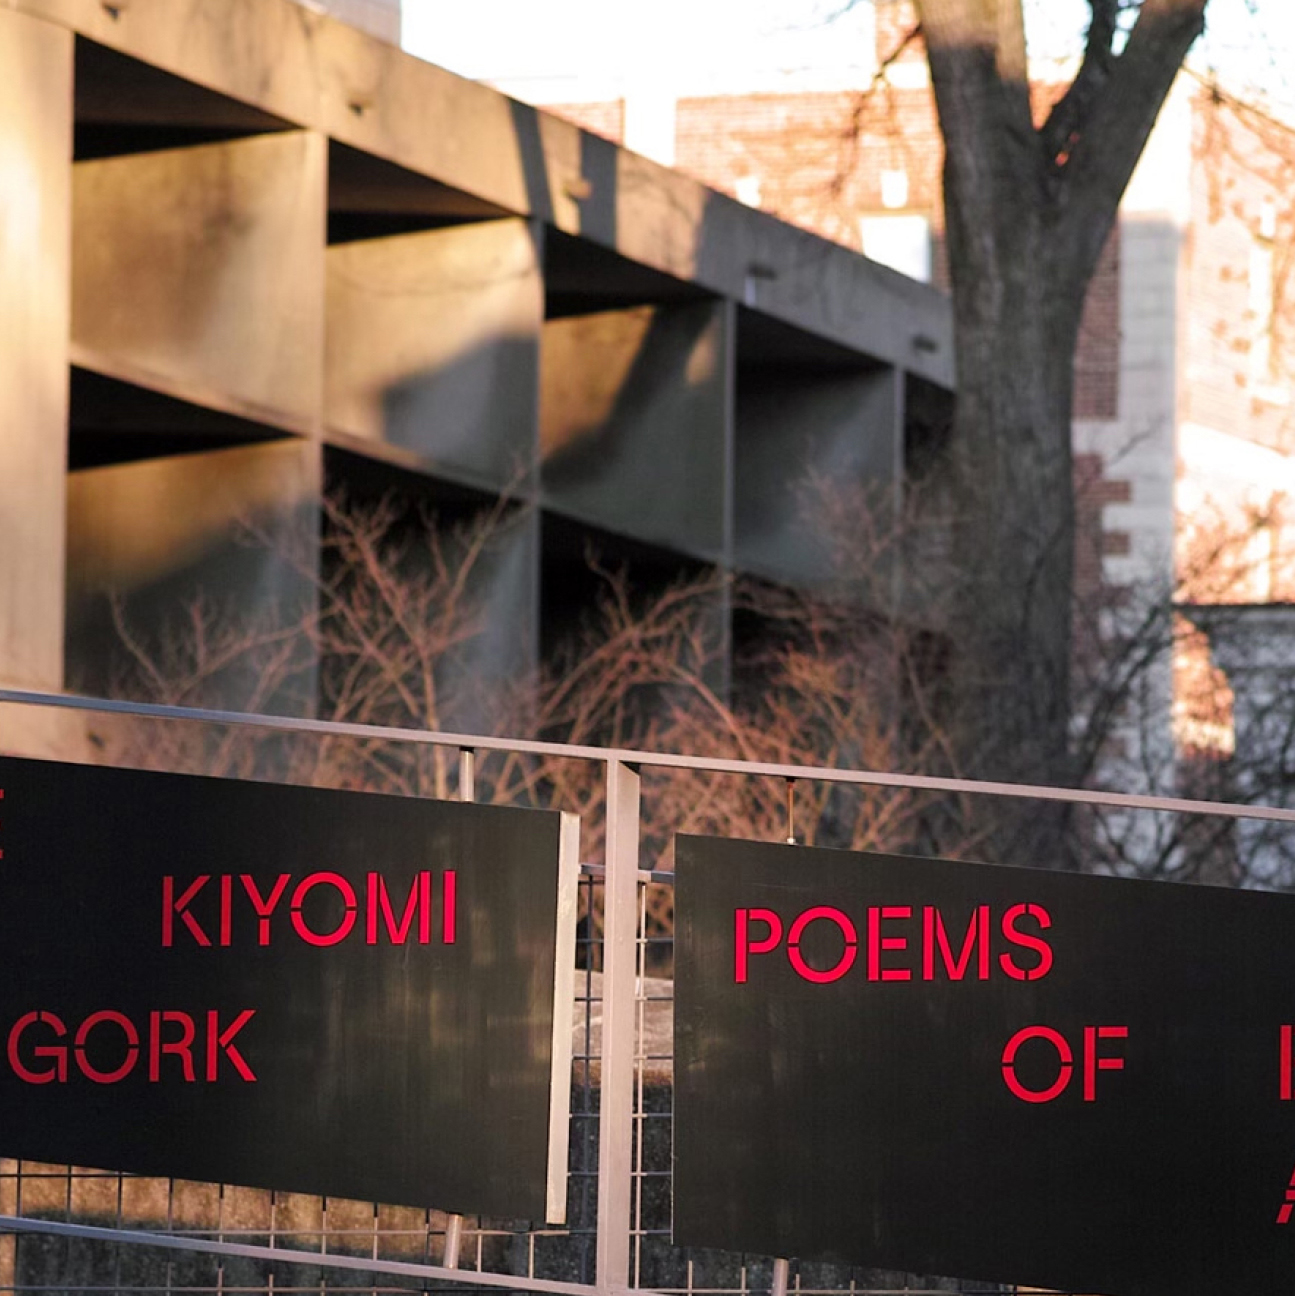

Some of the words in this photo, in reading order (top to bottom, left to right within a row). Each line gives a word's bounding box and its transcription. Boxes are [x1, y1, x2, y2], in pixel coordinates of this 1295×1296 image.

[162, 868, 458, 948] KIYOMI
[733, 902, 1054, 985] POEMS
[7, 1009, 257, 1085] GORK
[1000, 1025, 1129, 1104] OF
